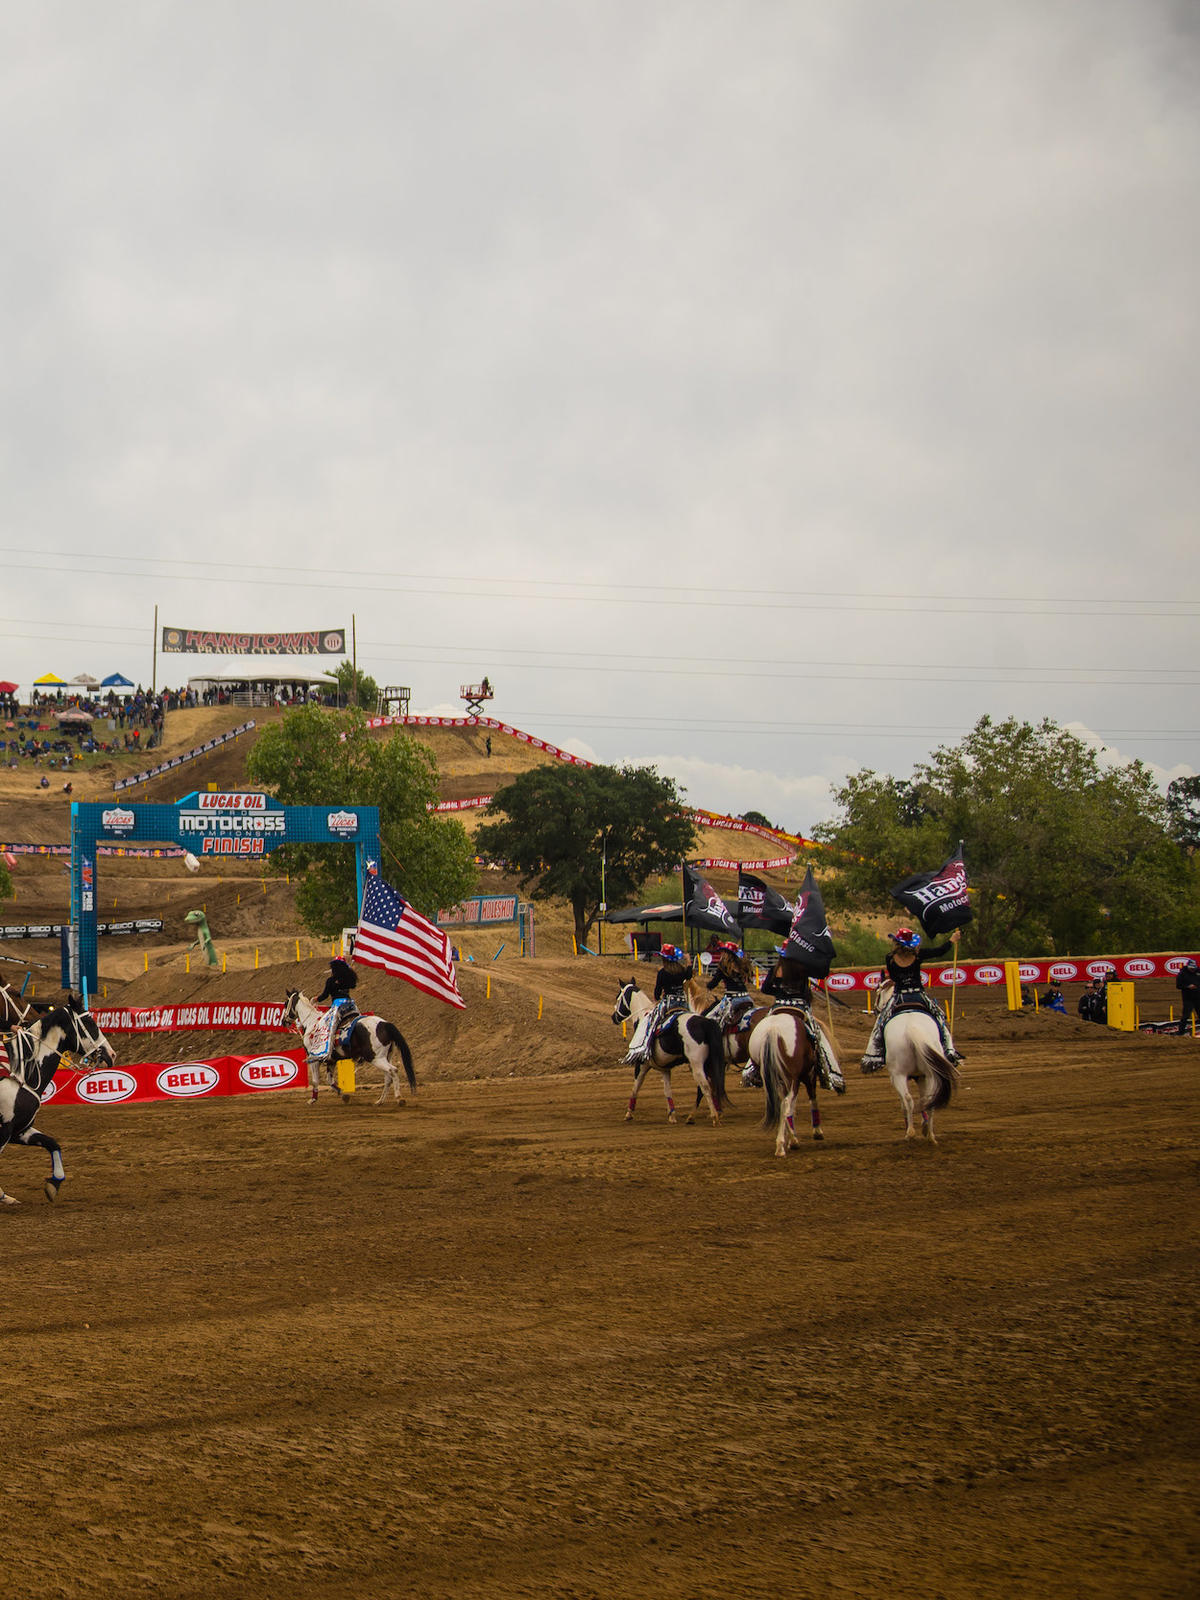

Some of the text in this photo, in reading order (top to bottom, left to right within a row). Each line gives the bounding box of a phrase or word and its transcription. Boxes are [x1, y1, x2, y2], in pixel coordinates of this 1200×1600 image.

[186, 630, 320, 648] HANGTOWN
[197, 646, 247, 654] PRAIRIE
[202, 795, 262, 808] LUCAS OIL
[179, 816, 286, 831] MOTOCROSS
[202, 836, 265, 854] FINISH
[481, 900, 515, 920] HOLESHOT
[1053, 967, 1073, 976] BELL
[1129, 964, 1150, 972] BELL
[97, 1012, 119, 1029] LUCAS
[121, 1011, 133, 1029] OIL
[134, 1010, 160, 1028] LUCAS
[161, 1009, 174, 1028] OIL
[176, 1008, 197, 1026] LUCAS
[198, 1006, 210, 1026] OIL
[212, 1007, 240, 1026] LUCAS
[242, 1006, 257, 1025] OIL
[86, 1063, 290, 1095] BELL BELL BELL
